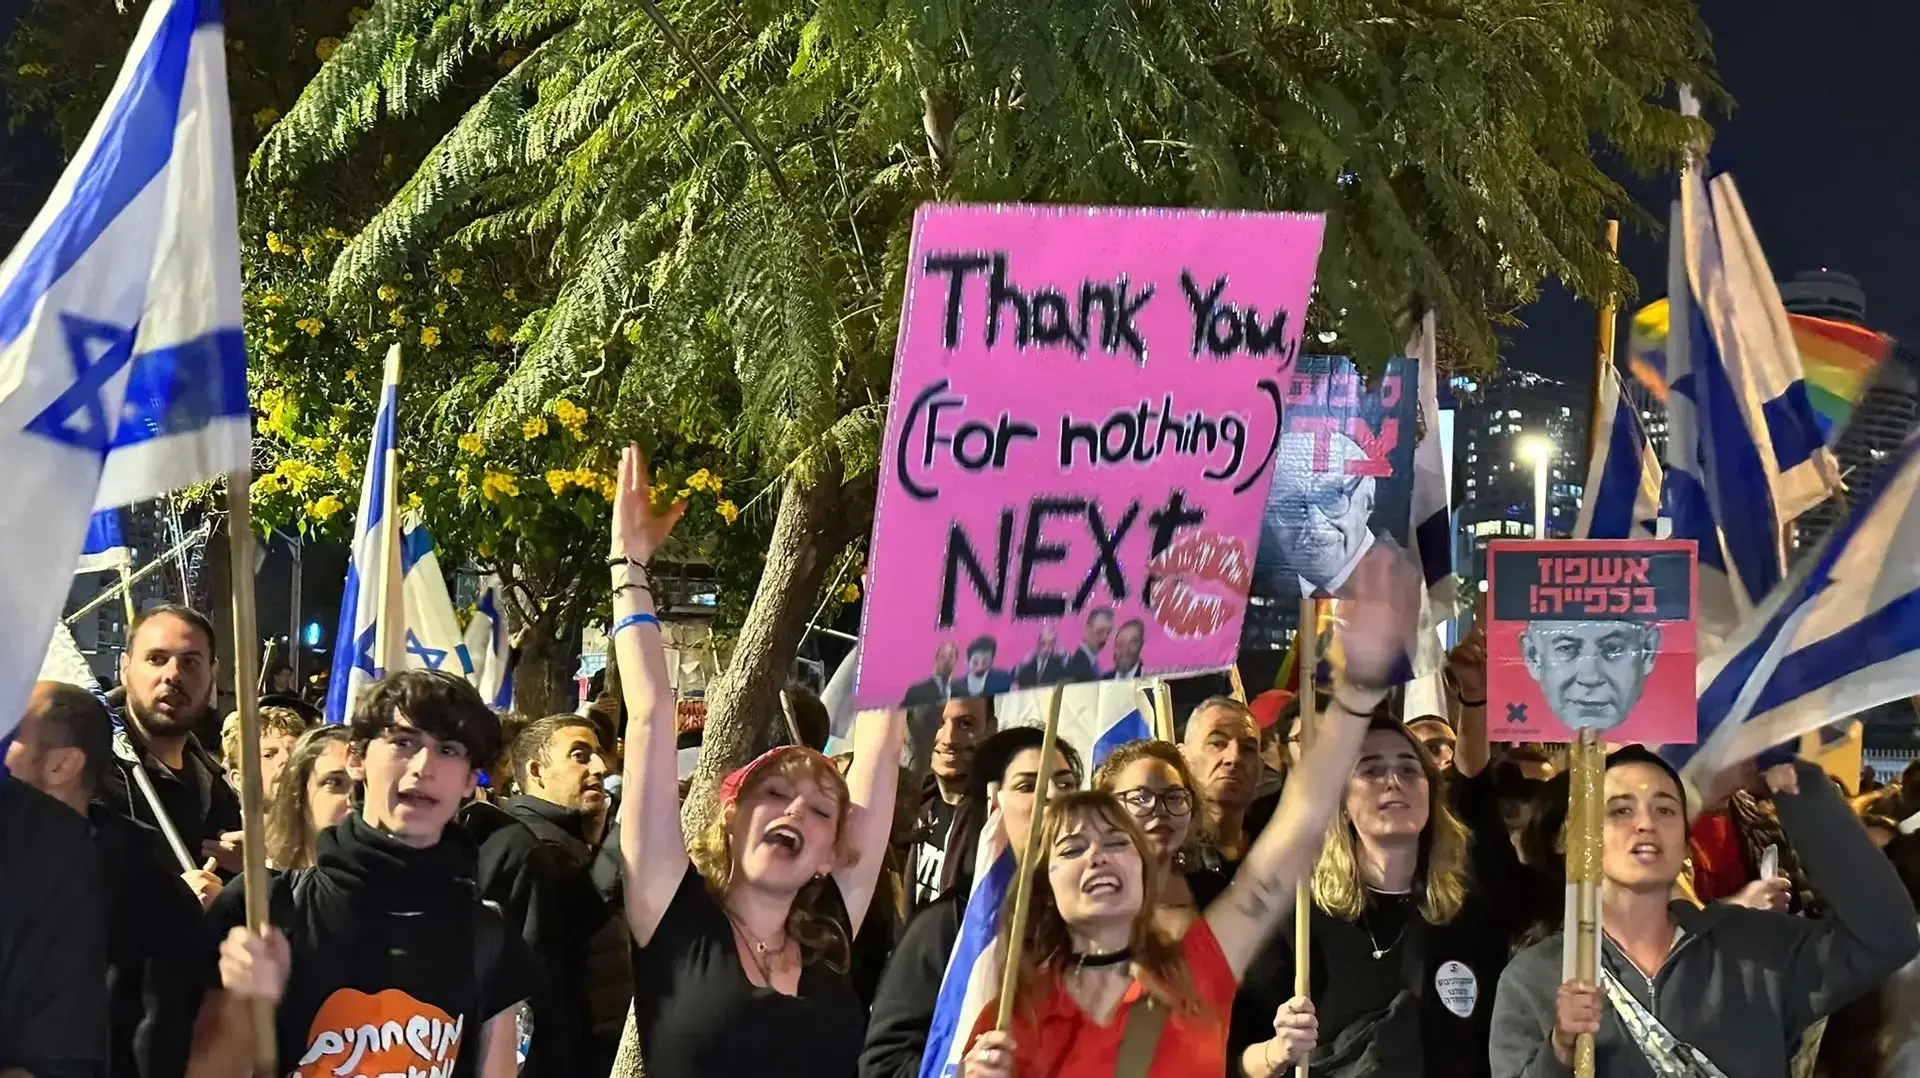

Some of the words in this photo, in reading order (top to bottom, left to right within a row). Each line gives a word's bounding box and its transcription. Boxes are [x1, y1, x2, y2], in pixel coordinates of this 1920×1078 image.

[924, 250, 1154, 363] Thank
[1181, 267, 1295, 372] You,
[897, 379, 1037, 499] (For
[1060, 379, 1283, 494] nothing)
[1529, 586, 1657, 614] בכפייה!
[1538, 557, 1650, 584] אשפוז
[299, 1013, 464, 1076] מושחתים
